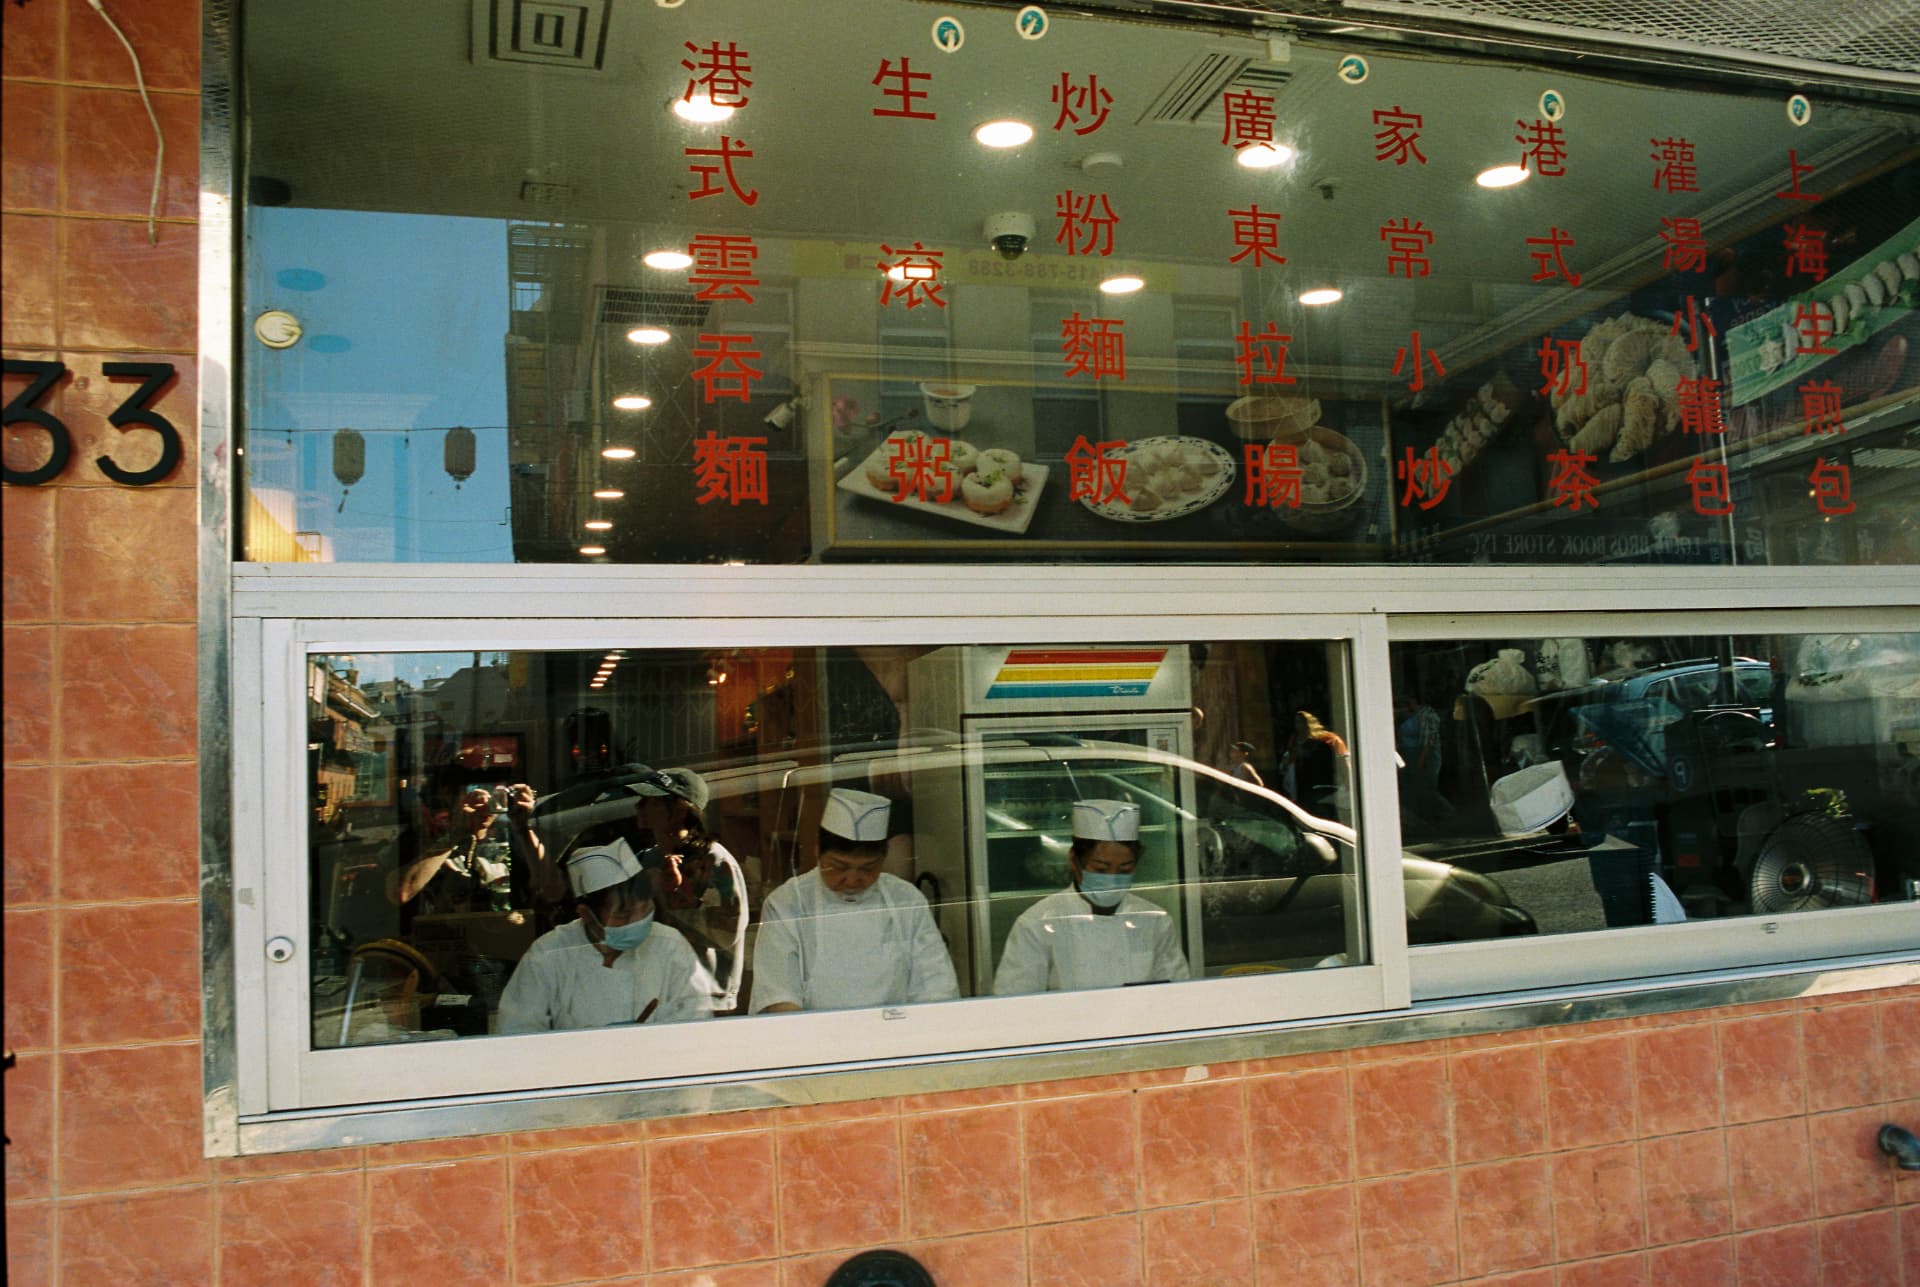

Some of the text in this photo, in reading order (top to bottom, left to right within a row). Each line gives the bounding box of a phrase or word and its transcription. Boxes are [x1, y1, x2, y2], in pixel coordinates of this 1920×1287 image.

[3, 361, 180, 485] 33
[681, 41, 768, 506] 港式雲吞麵
[872, 57, 953, 504] 生滾粥
[1051, 72, 1132, 506] 炒粉麵飯
[1221, 89, 1303, 508] 廣東拉腸
[1372, 105, 1453, 511] 家常小炒
[1515, 119, 1600, 512] 港式奶茶
[1649, 137, 1735, 515] 灌湯小籠包
[1776, 149, 1856, 515] 上海生煎包
